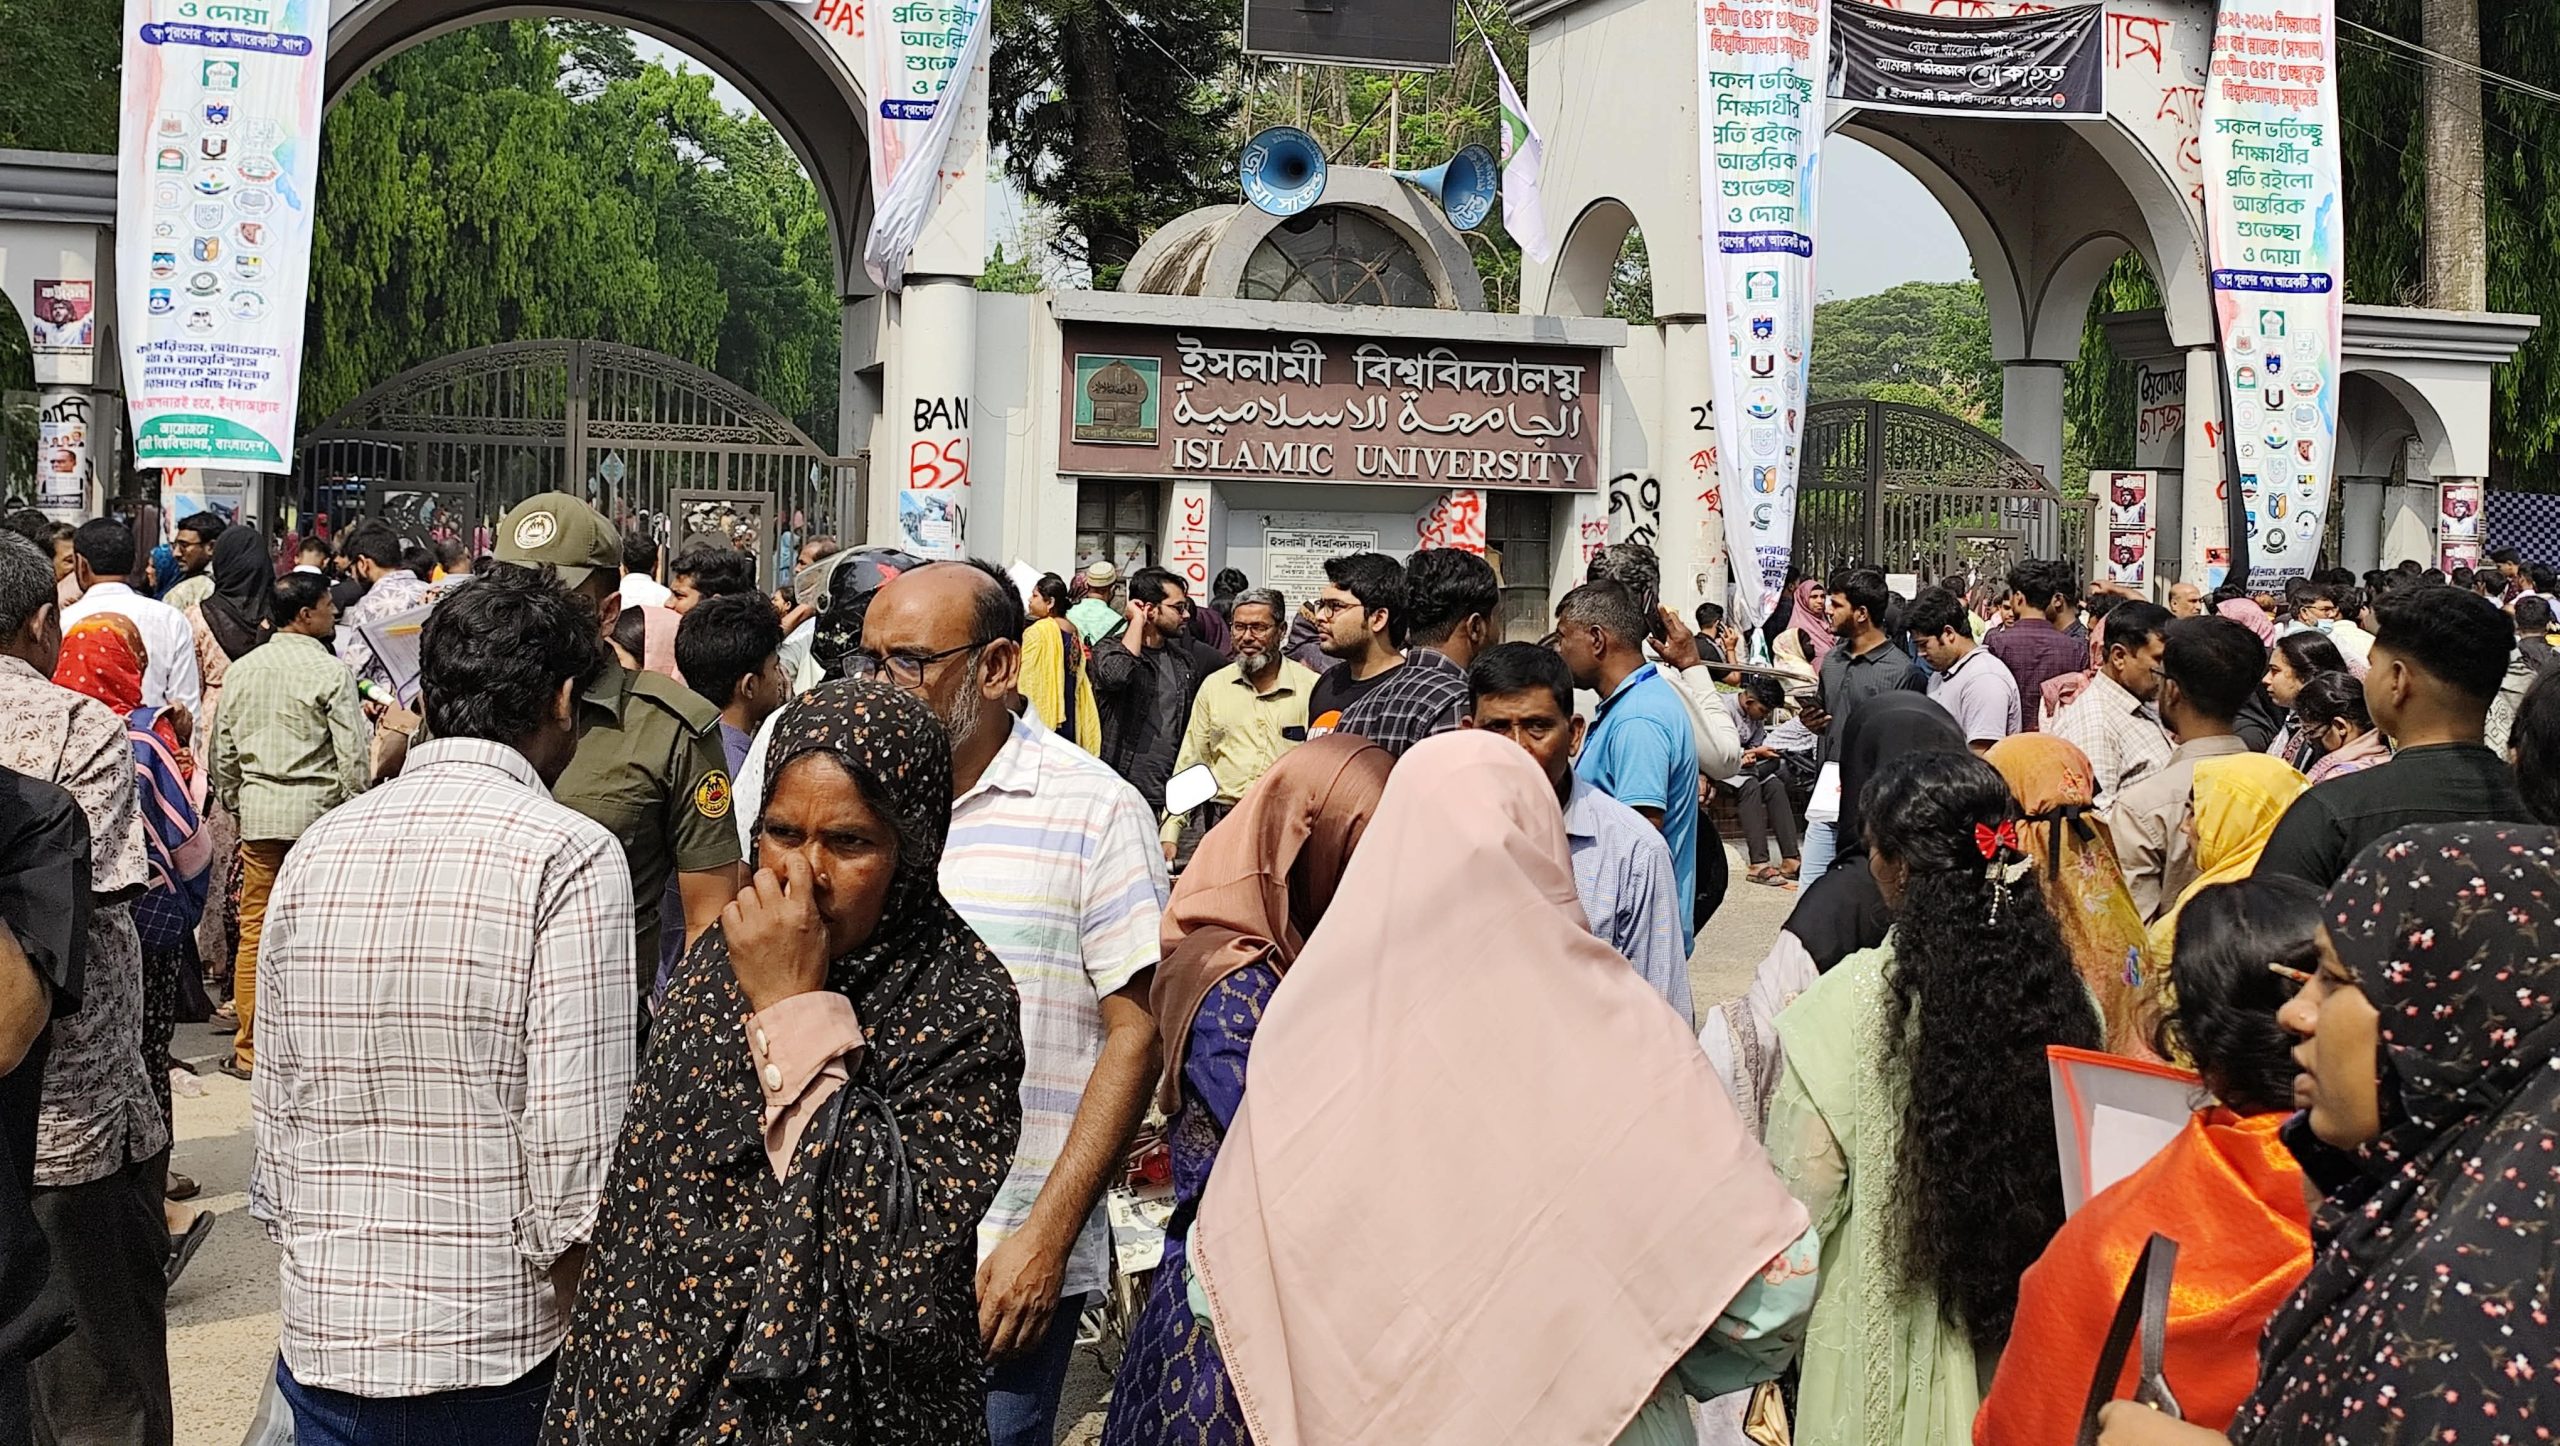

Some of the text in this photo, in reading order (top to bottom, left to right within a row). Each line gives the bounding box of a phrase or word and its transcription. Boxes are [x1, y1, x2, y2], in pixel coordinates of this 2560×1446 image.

[178, 3, 269, 25] ও দোয়া
[892, 2, 934, 24] প্রতি
[1741, 10, 1774, 28] GST
[230, 32, 279, 48] আরেকটি
[282, 38, 304, 52] ধাপ
[1711, 28, 1778, 55] বিশ্ববিদ্যালয়
[1875, 57, 1912, 73] আমরা
[1968, 63, 2067, 91] শোকাহত
[2249, 61, 2276, 80] GST
[912, 81, 928, 94] ও
[1889, 86, 1934, 101] ইসলামী
[1937, 91, 2006, 105] বিশ্ববিদ্যালয়
[2222, 78, 2280, 106] বিশ্ববিদ্যালয়
[1717, 93, 1800, 118] শিক্ষার্থীর
[1713, 121, 1801, 145] প্রতি রইলো
[2214, 117, 2323, 147] সকল ভর্তিচ্ছু
[1717, 147, 1797, 171] আন্তরিক
[2232, 139, 2309, 165] শিক্ষার্থীর
[1722, 179, 1795, 198] শুভেচ্ছা
[2226, 165, 2314, 190] প্রতি রইলো
[1728, 206, 1794, 224] ও দোয়া
[2233, 193, 2306, 215] আন্তরিক
[2237, 221, 2301, 241] শুভেচ্ছা
[2243, 248, 2301, 267] ও দোয়া
[1176, 332, 1586, 401] ইসলামী বিশ্ববিদ্যালয়
[914, 396, 968, 432] BAN
[1397, 390, 1582, 448] الجامعة
[1172, 437, 1583, 483] ISLAMIC UNIVERSITY
